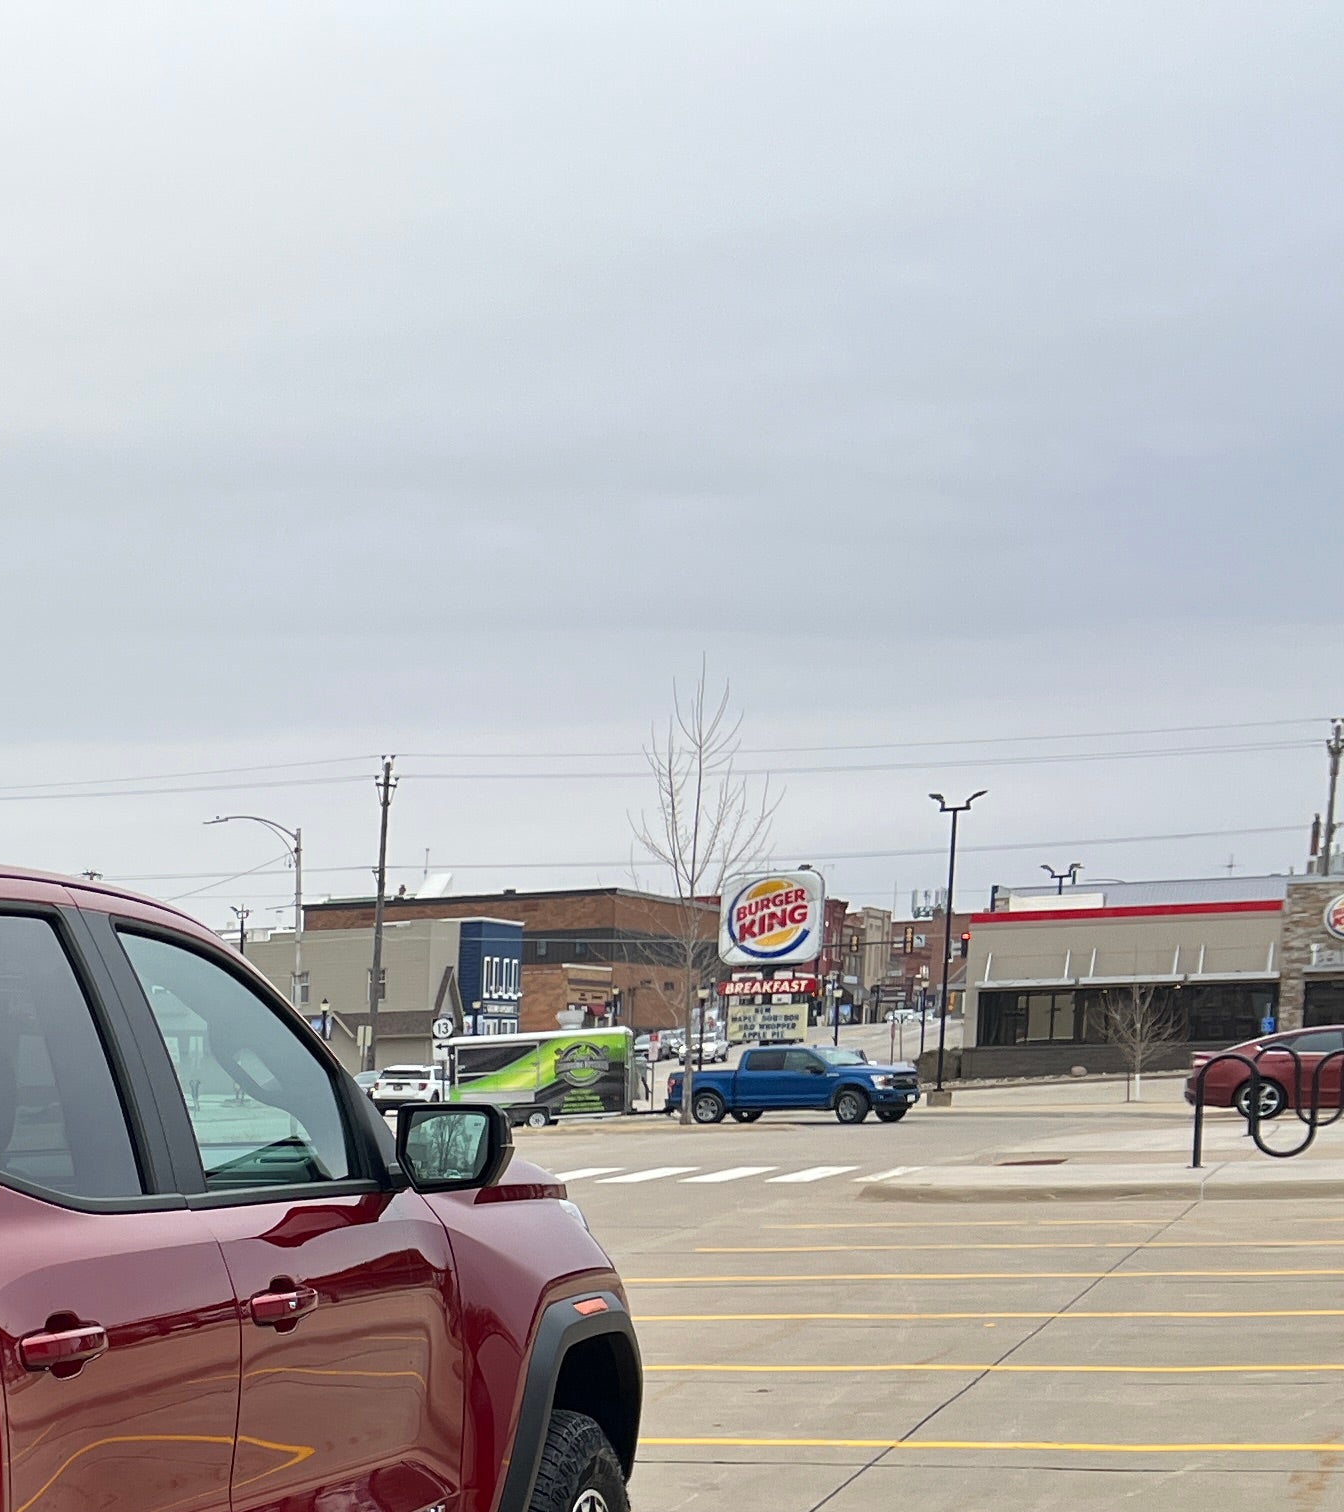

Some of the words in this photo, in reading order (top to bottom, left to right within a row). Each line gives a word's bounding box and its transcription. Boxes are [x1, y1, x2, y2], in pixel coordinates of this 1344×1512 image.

[736, 888, 806, 922] BURGER
[738, 904, 808, 943] KING
[725, 980, 808, 995] BREAKFAST
[437, 1022, 449, 1035] 13
